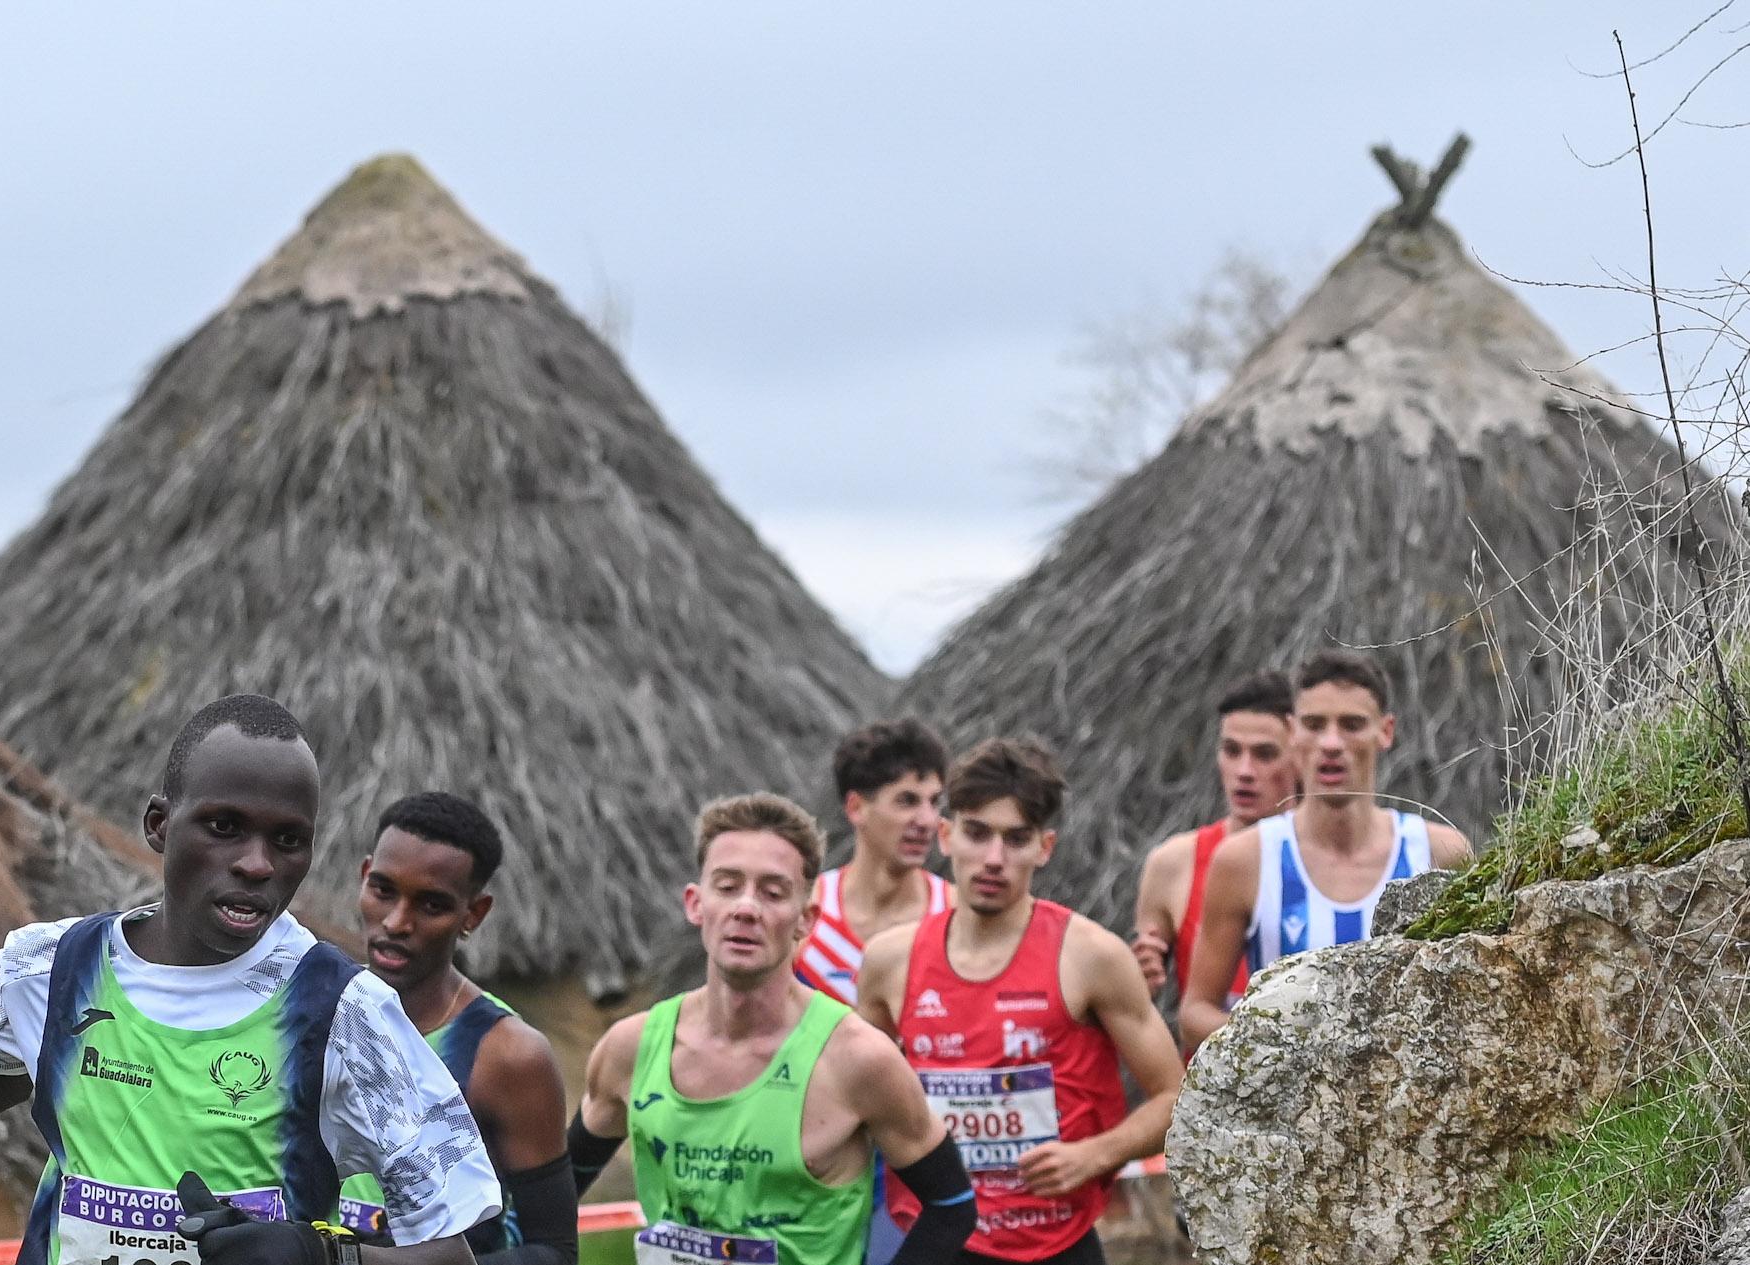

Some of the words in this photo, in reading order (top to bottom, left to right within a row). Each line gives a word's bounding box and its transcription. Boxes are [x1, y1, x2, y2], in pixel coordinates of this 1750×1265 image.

[101, 1056, 145, 1072] Ayuntamiento
[145, 1065, 154, 1075] de
[225, 1051, 260, 1066] CAUG
[100, 1066, 153, 1088] Guadalajara
[207, 1108, 258, 1121] www.caug.es
[674, 1142, 773, 1164] Fundación
[674, 1161, 745, 1184] Unicaja
[109, 1230, 187, 1253] Ibercaja
